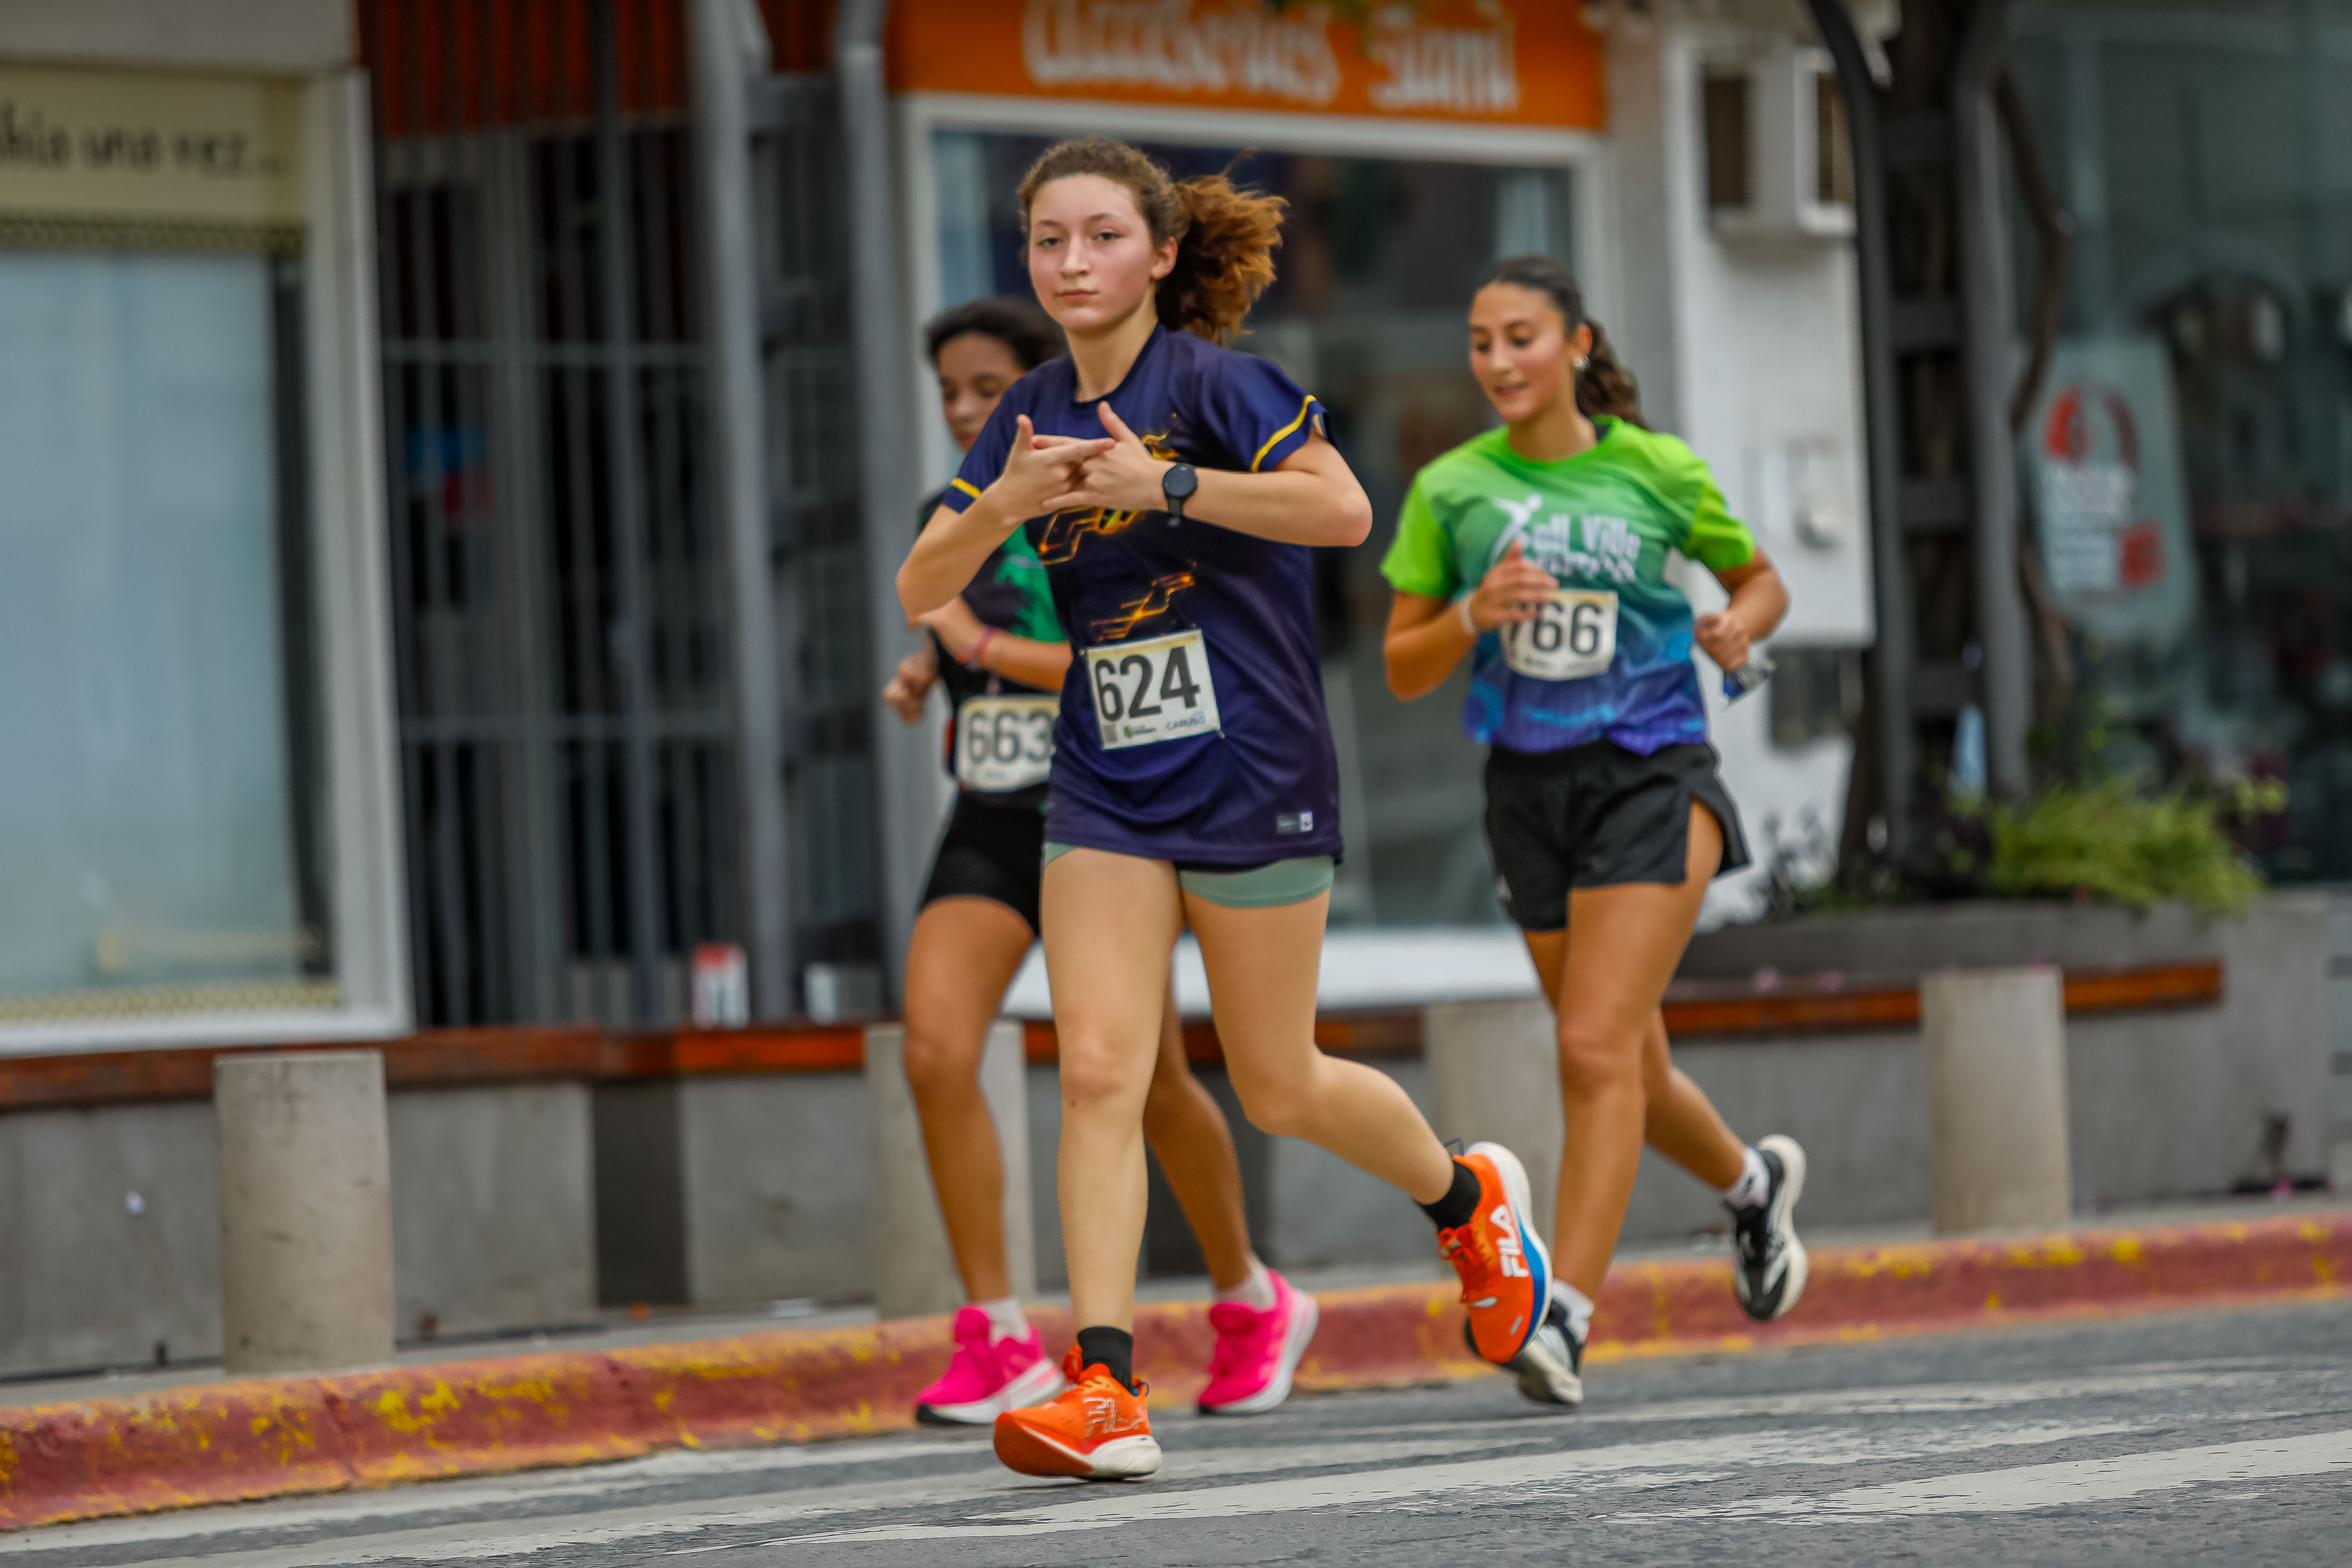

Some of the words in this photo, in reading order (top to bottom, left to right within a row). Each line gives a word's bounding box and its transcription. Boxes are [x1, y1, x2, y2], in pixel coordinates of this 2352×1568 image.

[1095, 646, 1201, 722] 624
[968, 710, 1054, 763] 663
[1489, 1204, 1530, 1278] FILA
